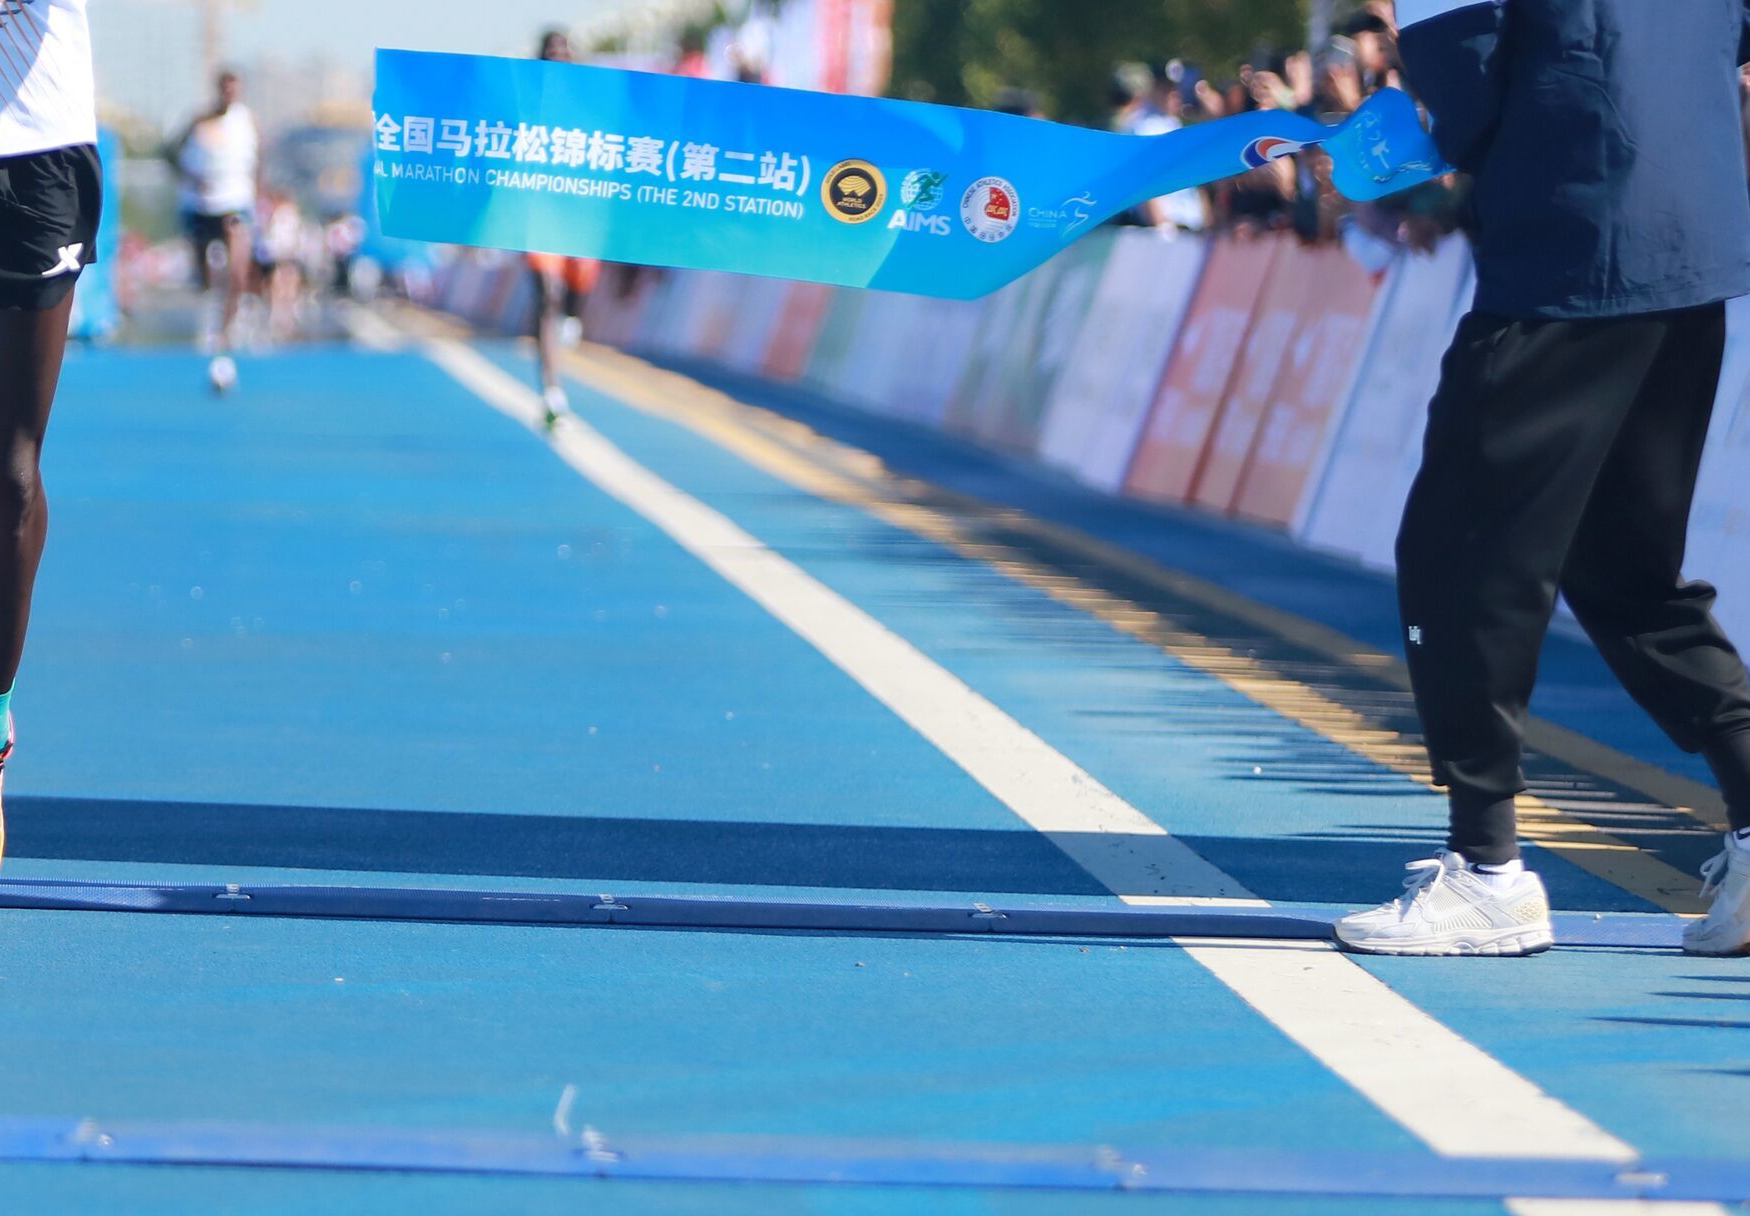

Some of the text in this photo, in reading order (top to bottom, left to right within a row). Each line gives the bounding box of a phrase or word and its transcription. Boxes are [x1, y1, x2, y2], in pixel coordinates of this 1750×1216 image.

[375, 112, 811, 197] 全国马拉松锦标赛(第二站)
[392, 161, 480, 184] MARATHON
[485, 168, 632, 201] CHAMPIONSHIPS
[636, 185, 679, 205] (THE
[683, 190, 720, 210] 2ND
[723, 195, 804, 221] STATION)
[1028, 207, 1068, 219] CHINA
[886, 208, 952, 236] AIMS
